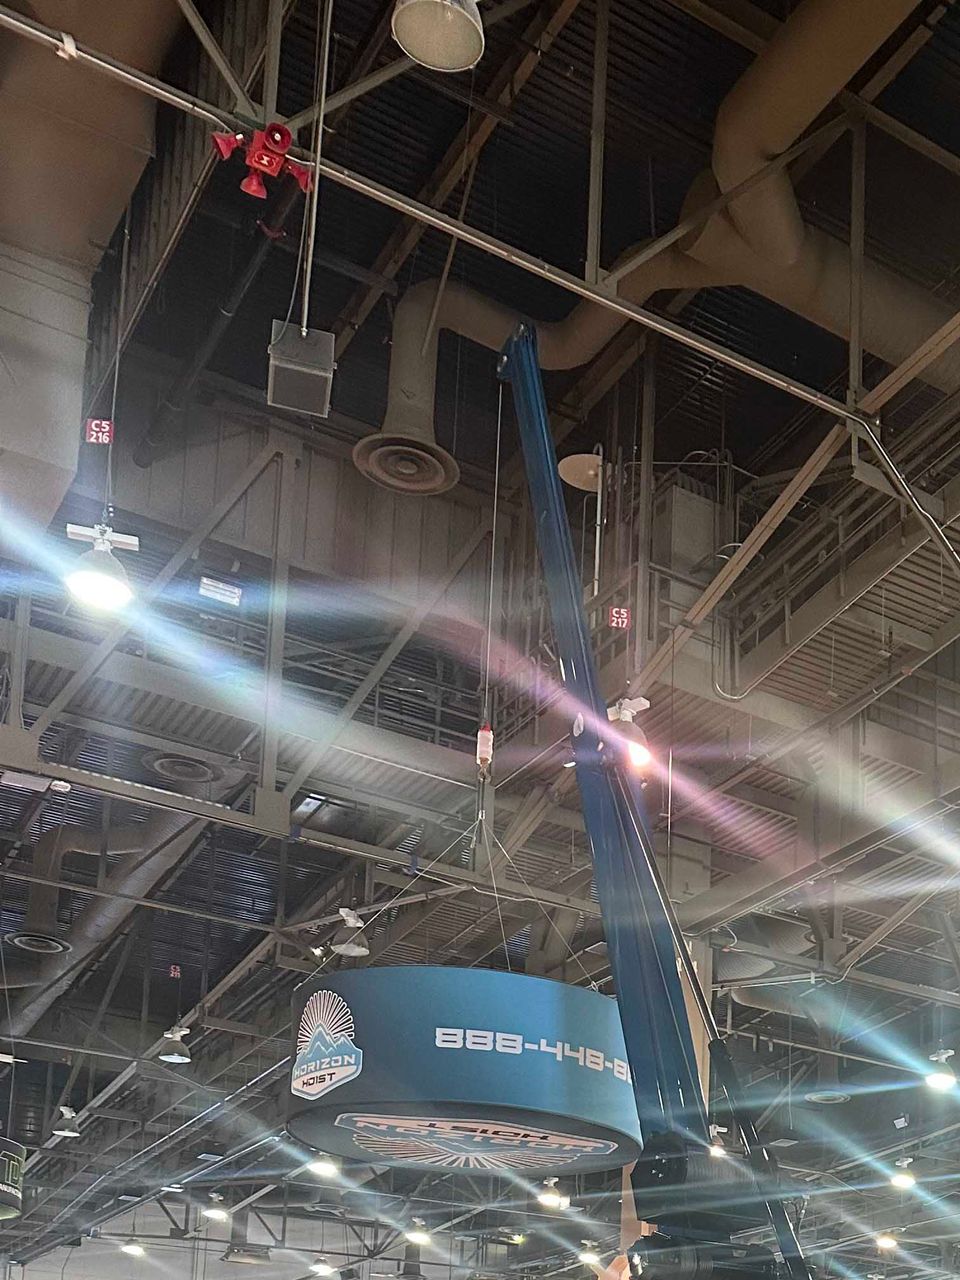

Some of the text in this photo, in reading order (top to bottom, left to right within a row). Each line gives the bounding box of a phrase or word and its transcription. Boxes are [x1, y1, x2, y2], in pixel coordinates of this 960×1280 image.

[91, 420, 111, 432] C5
[90, 431, 111, 444] 216
[612, 607, 628, 618] C5
[611, 617, 628, 628] 217
[435, 1027, 633, 1085] 888-448-8
[294, 1054, 357, 1079] HORIZON
[301, 1072, 337, 1089] HOIST
[416, 1122, 551, 1141] HOIST
